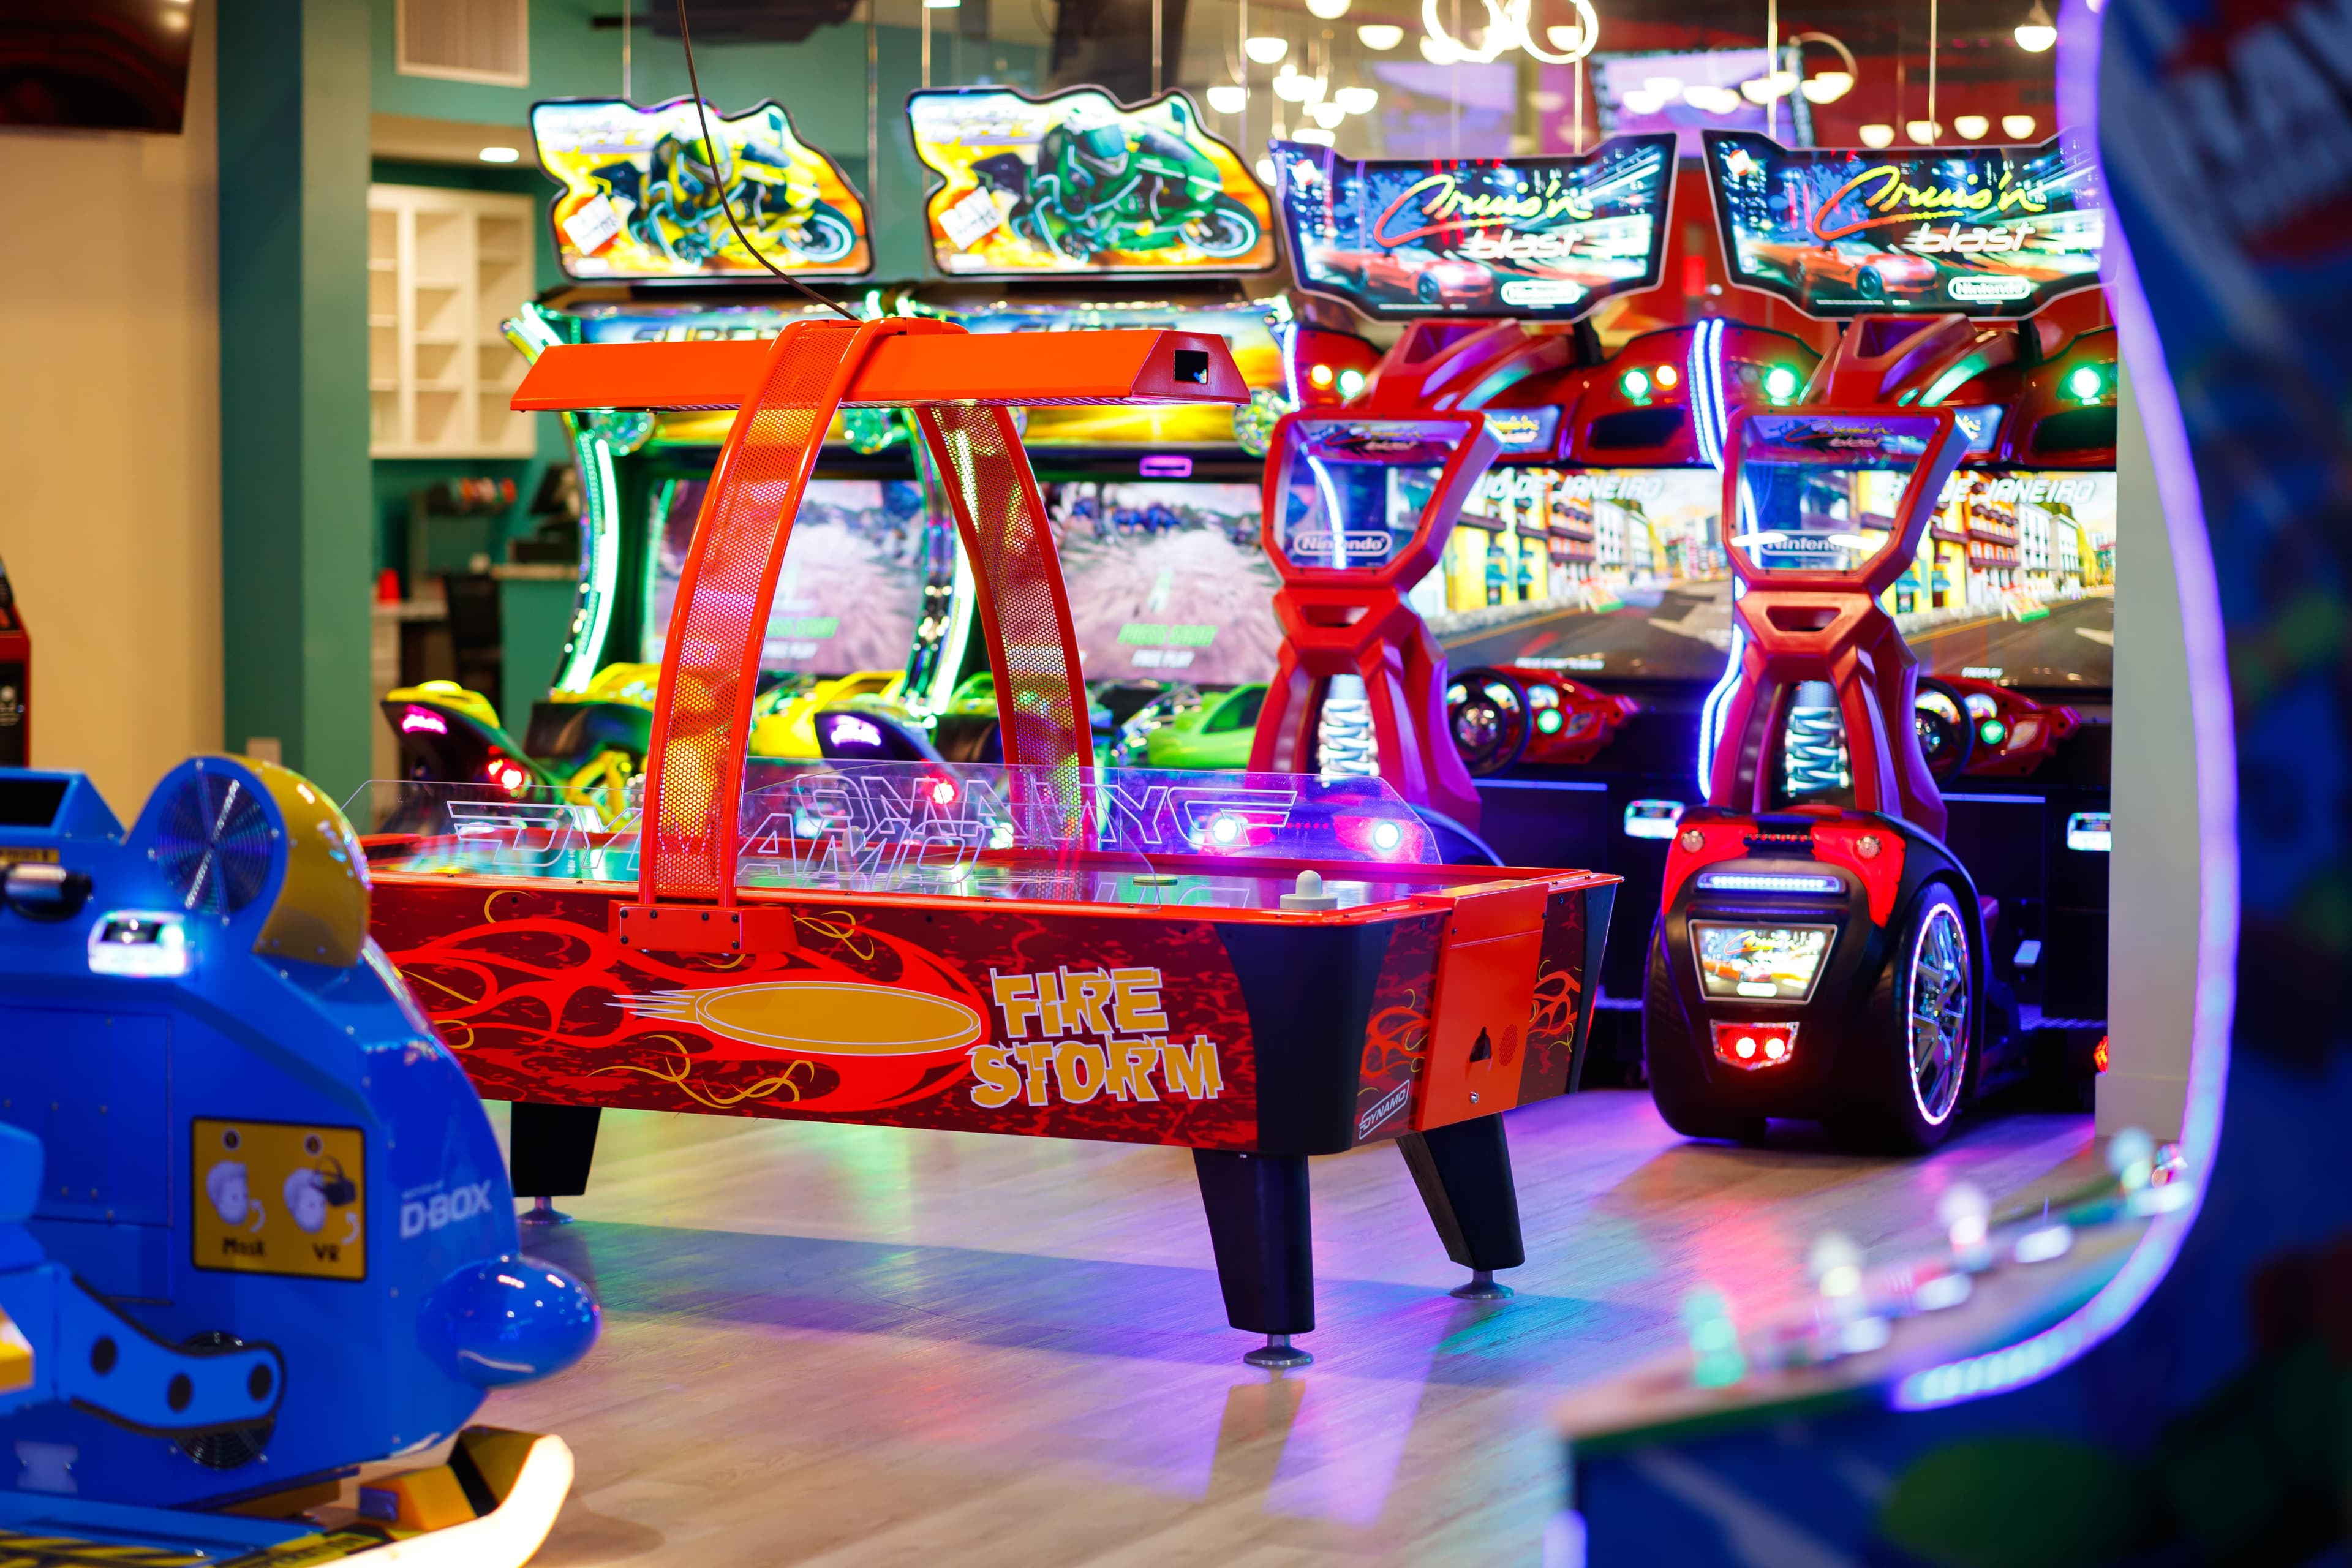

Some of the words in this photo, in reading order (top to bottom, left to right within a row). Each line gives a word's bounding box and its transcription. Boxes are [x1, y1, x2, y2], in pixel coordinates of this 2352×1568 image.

[1374, 173, 1594, 247] Cruis'n
[1813, 165, 2046, 241] Cruis'n
[1468, 229, 1584, 260] blast
[1912, 221, 2036, 253] blast
[1556, 475, 1664, 500] JANEIRO
[1981, 478, 2096, 504] JANEIRO
[989, 965, 1169, 1038] FIRE
[965, 1033, 1224, 1108] STORM
[1359, 1088, 1406, 1131] DYNAMO
